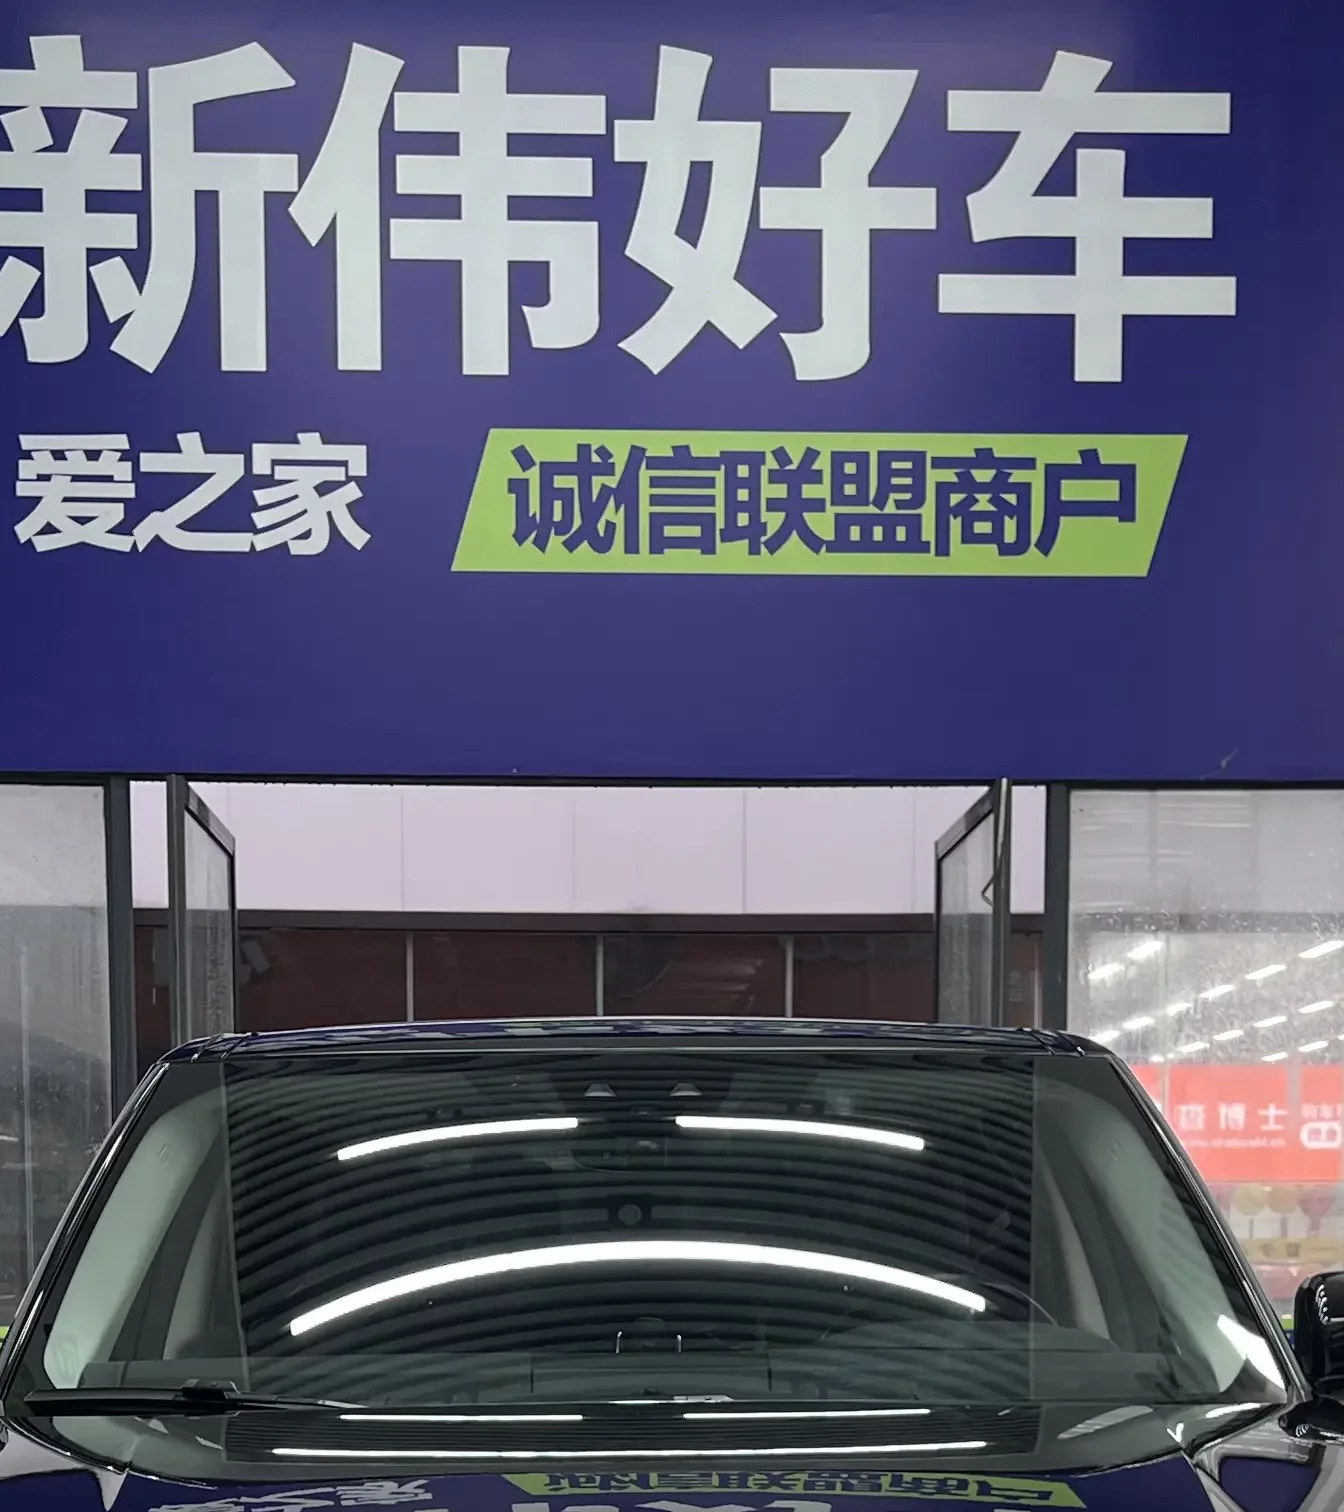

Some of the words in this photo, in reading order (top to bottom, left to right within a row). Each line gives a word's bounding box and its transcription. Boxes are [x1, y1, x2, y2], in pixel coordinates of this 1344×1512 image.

[13, 432, 371, 556] 爱之家
[508, 443, 1138, 557] 诚信联盟商户
